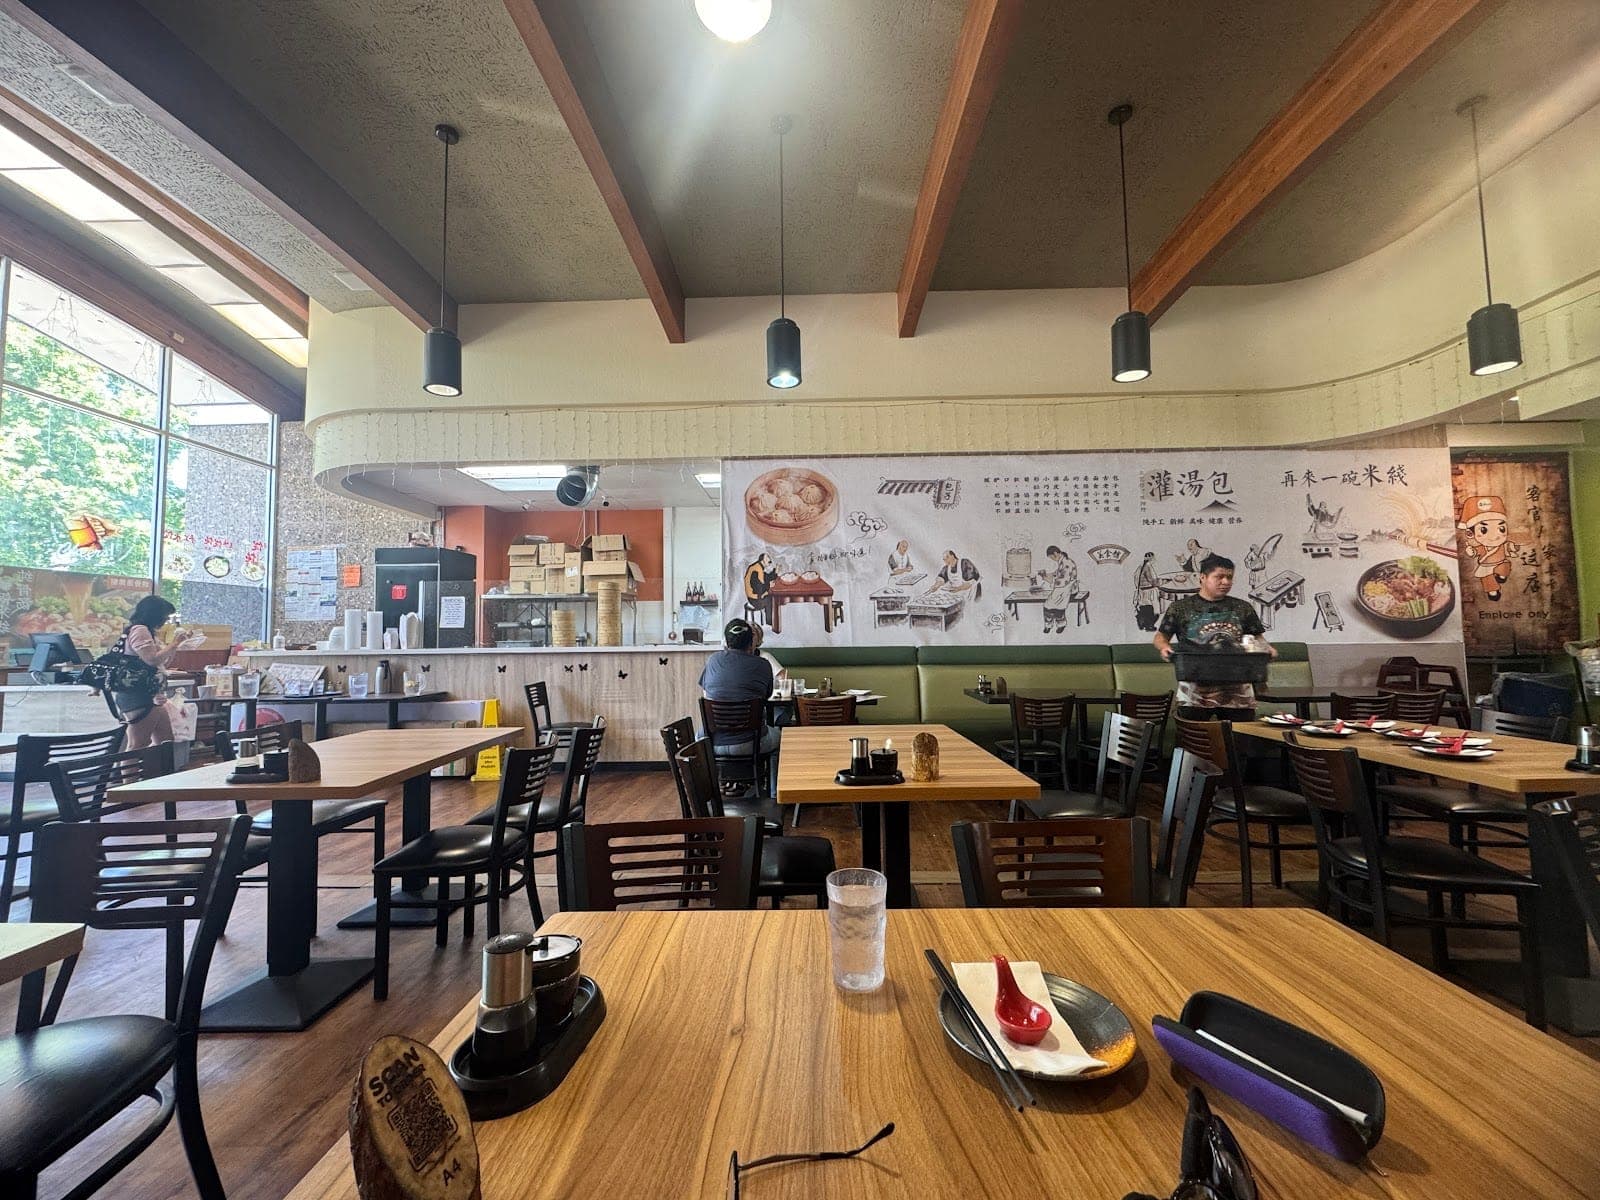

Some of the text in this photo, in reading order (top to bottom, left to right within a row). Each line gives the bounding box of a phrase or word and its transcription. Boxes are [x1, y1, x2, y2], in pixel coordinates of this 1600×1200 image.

[1147, 470, 1234, 501] 灌湯包
[368, 1046, 421, 1097] SCAN
[443, 1158, 462, 1187] A4
